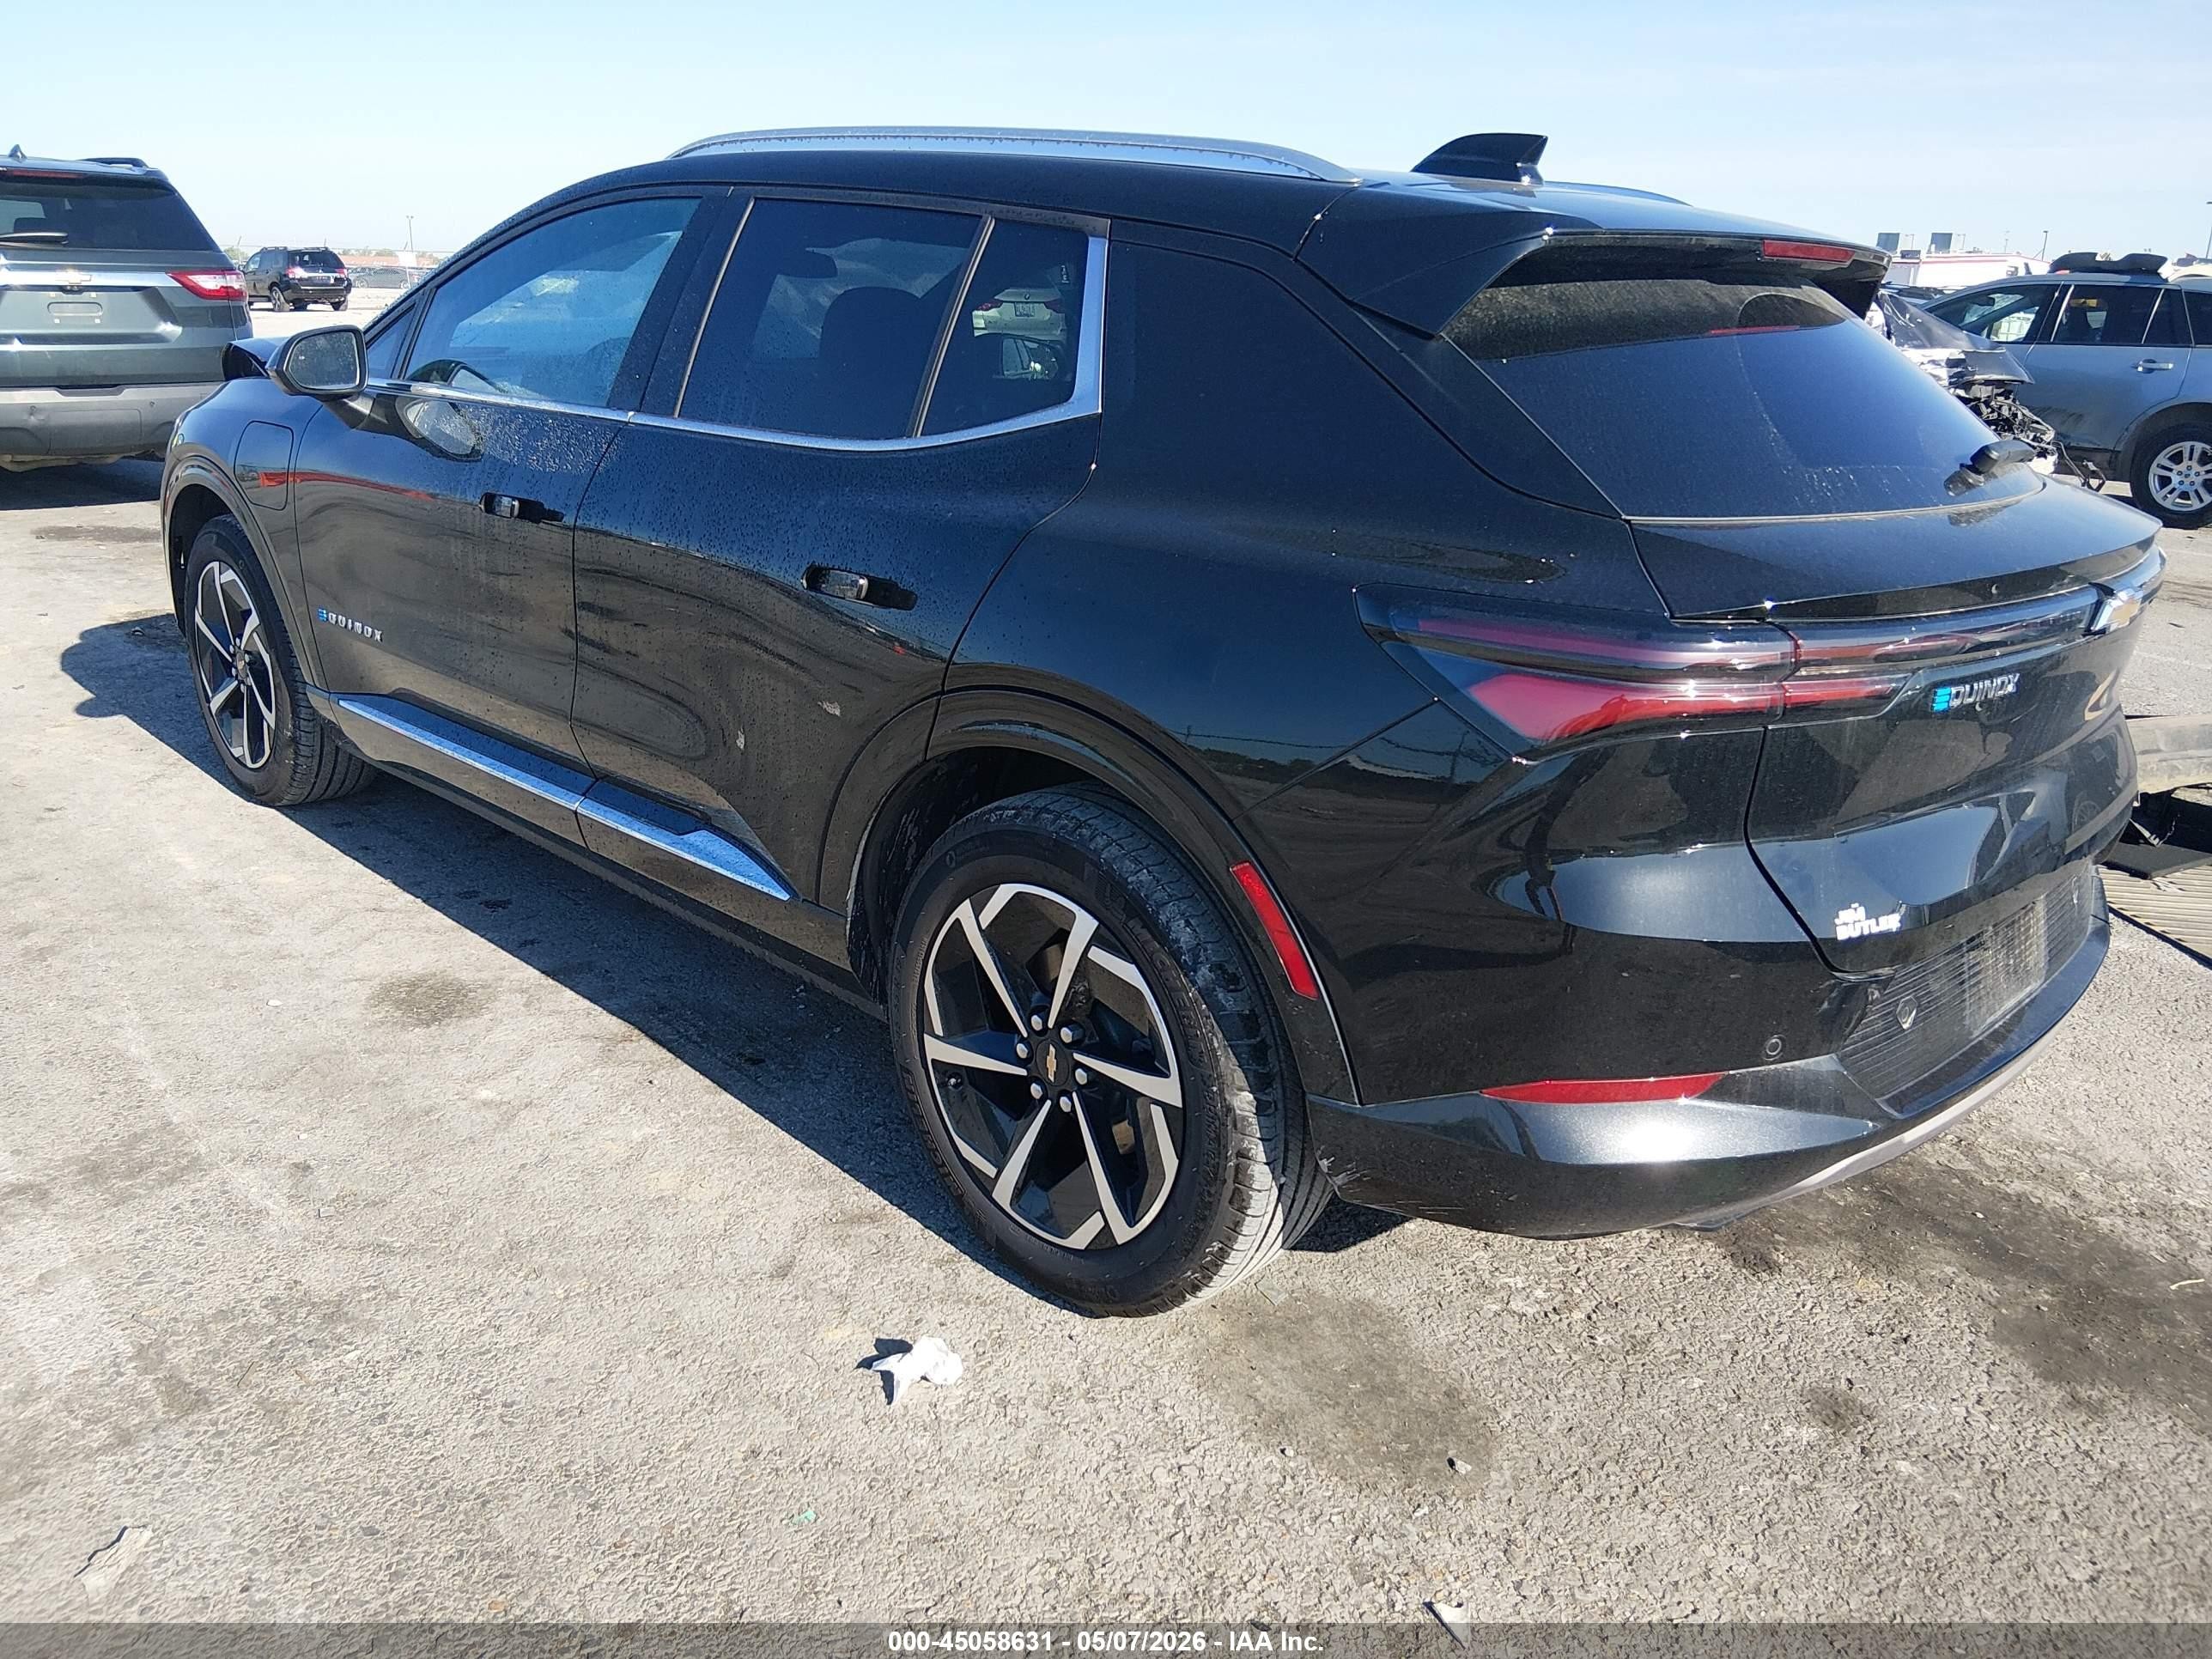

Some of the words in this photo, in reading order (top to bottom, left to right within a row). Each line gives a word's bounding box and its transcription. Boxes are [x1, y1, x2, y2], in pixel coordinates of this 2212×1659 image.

[317, 607, 383, 642] EQUINOX
[1932, 673, 2021, 713] EQUINOX
[1126, 911, 1207, 1064] MICHELIN
